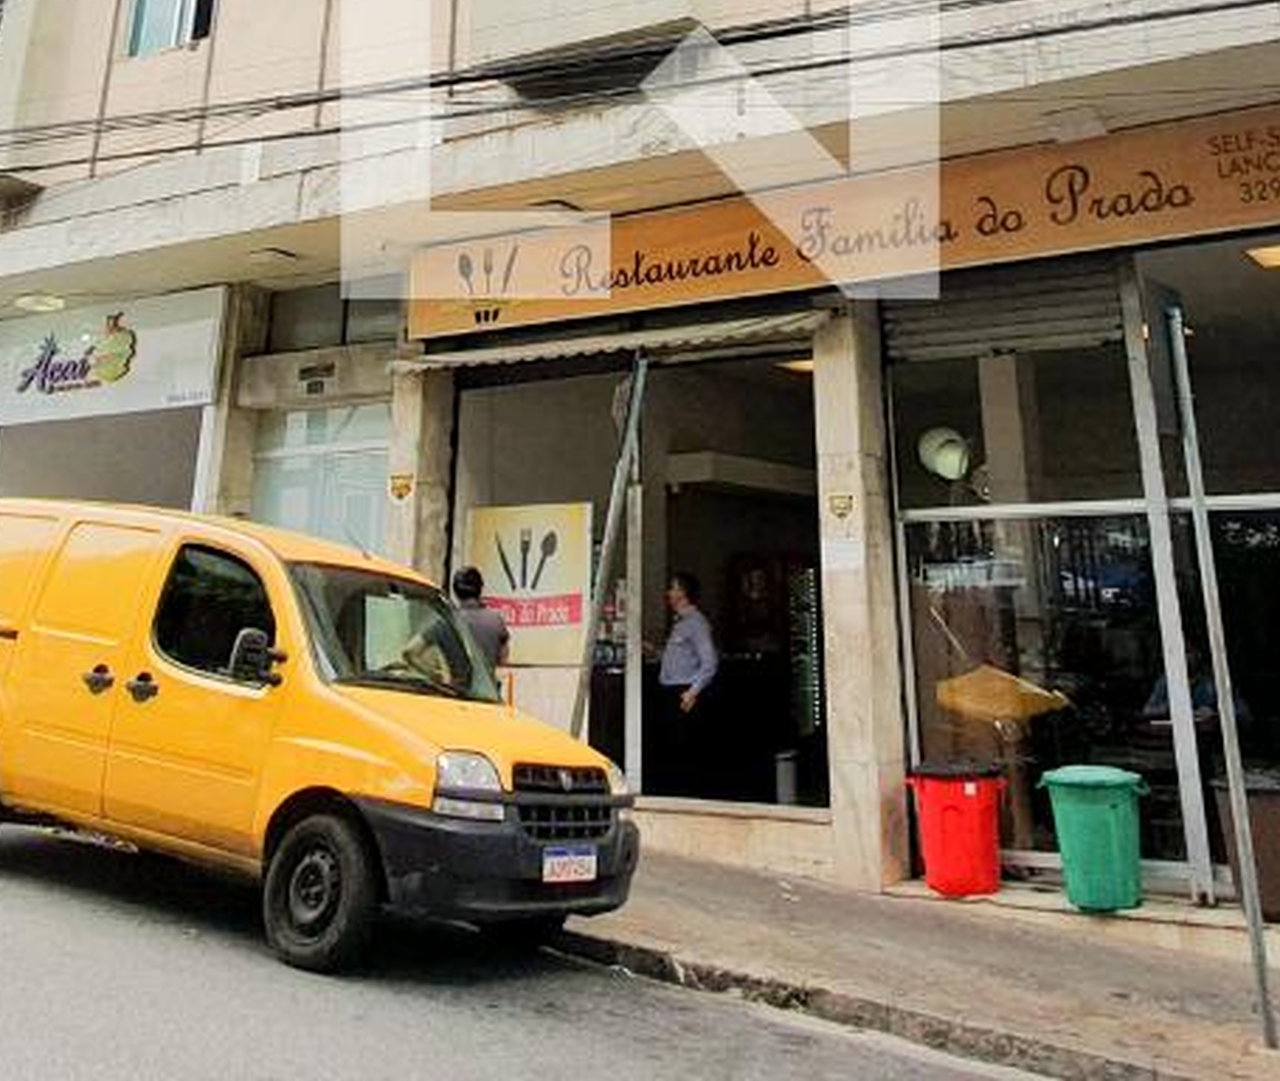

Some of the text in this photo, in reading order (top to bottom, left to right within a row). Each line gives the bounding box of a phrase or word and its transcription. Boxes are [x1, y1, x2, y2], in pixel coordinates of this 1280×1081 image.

[561, 231, 780, 297] Restaurante
[976, 196, 1028, 237] do
[1045, 164, 1197, 226] Prado
